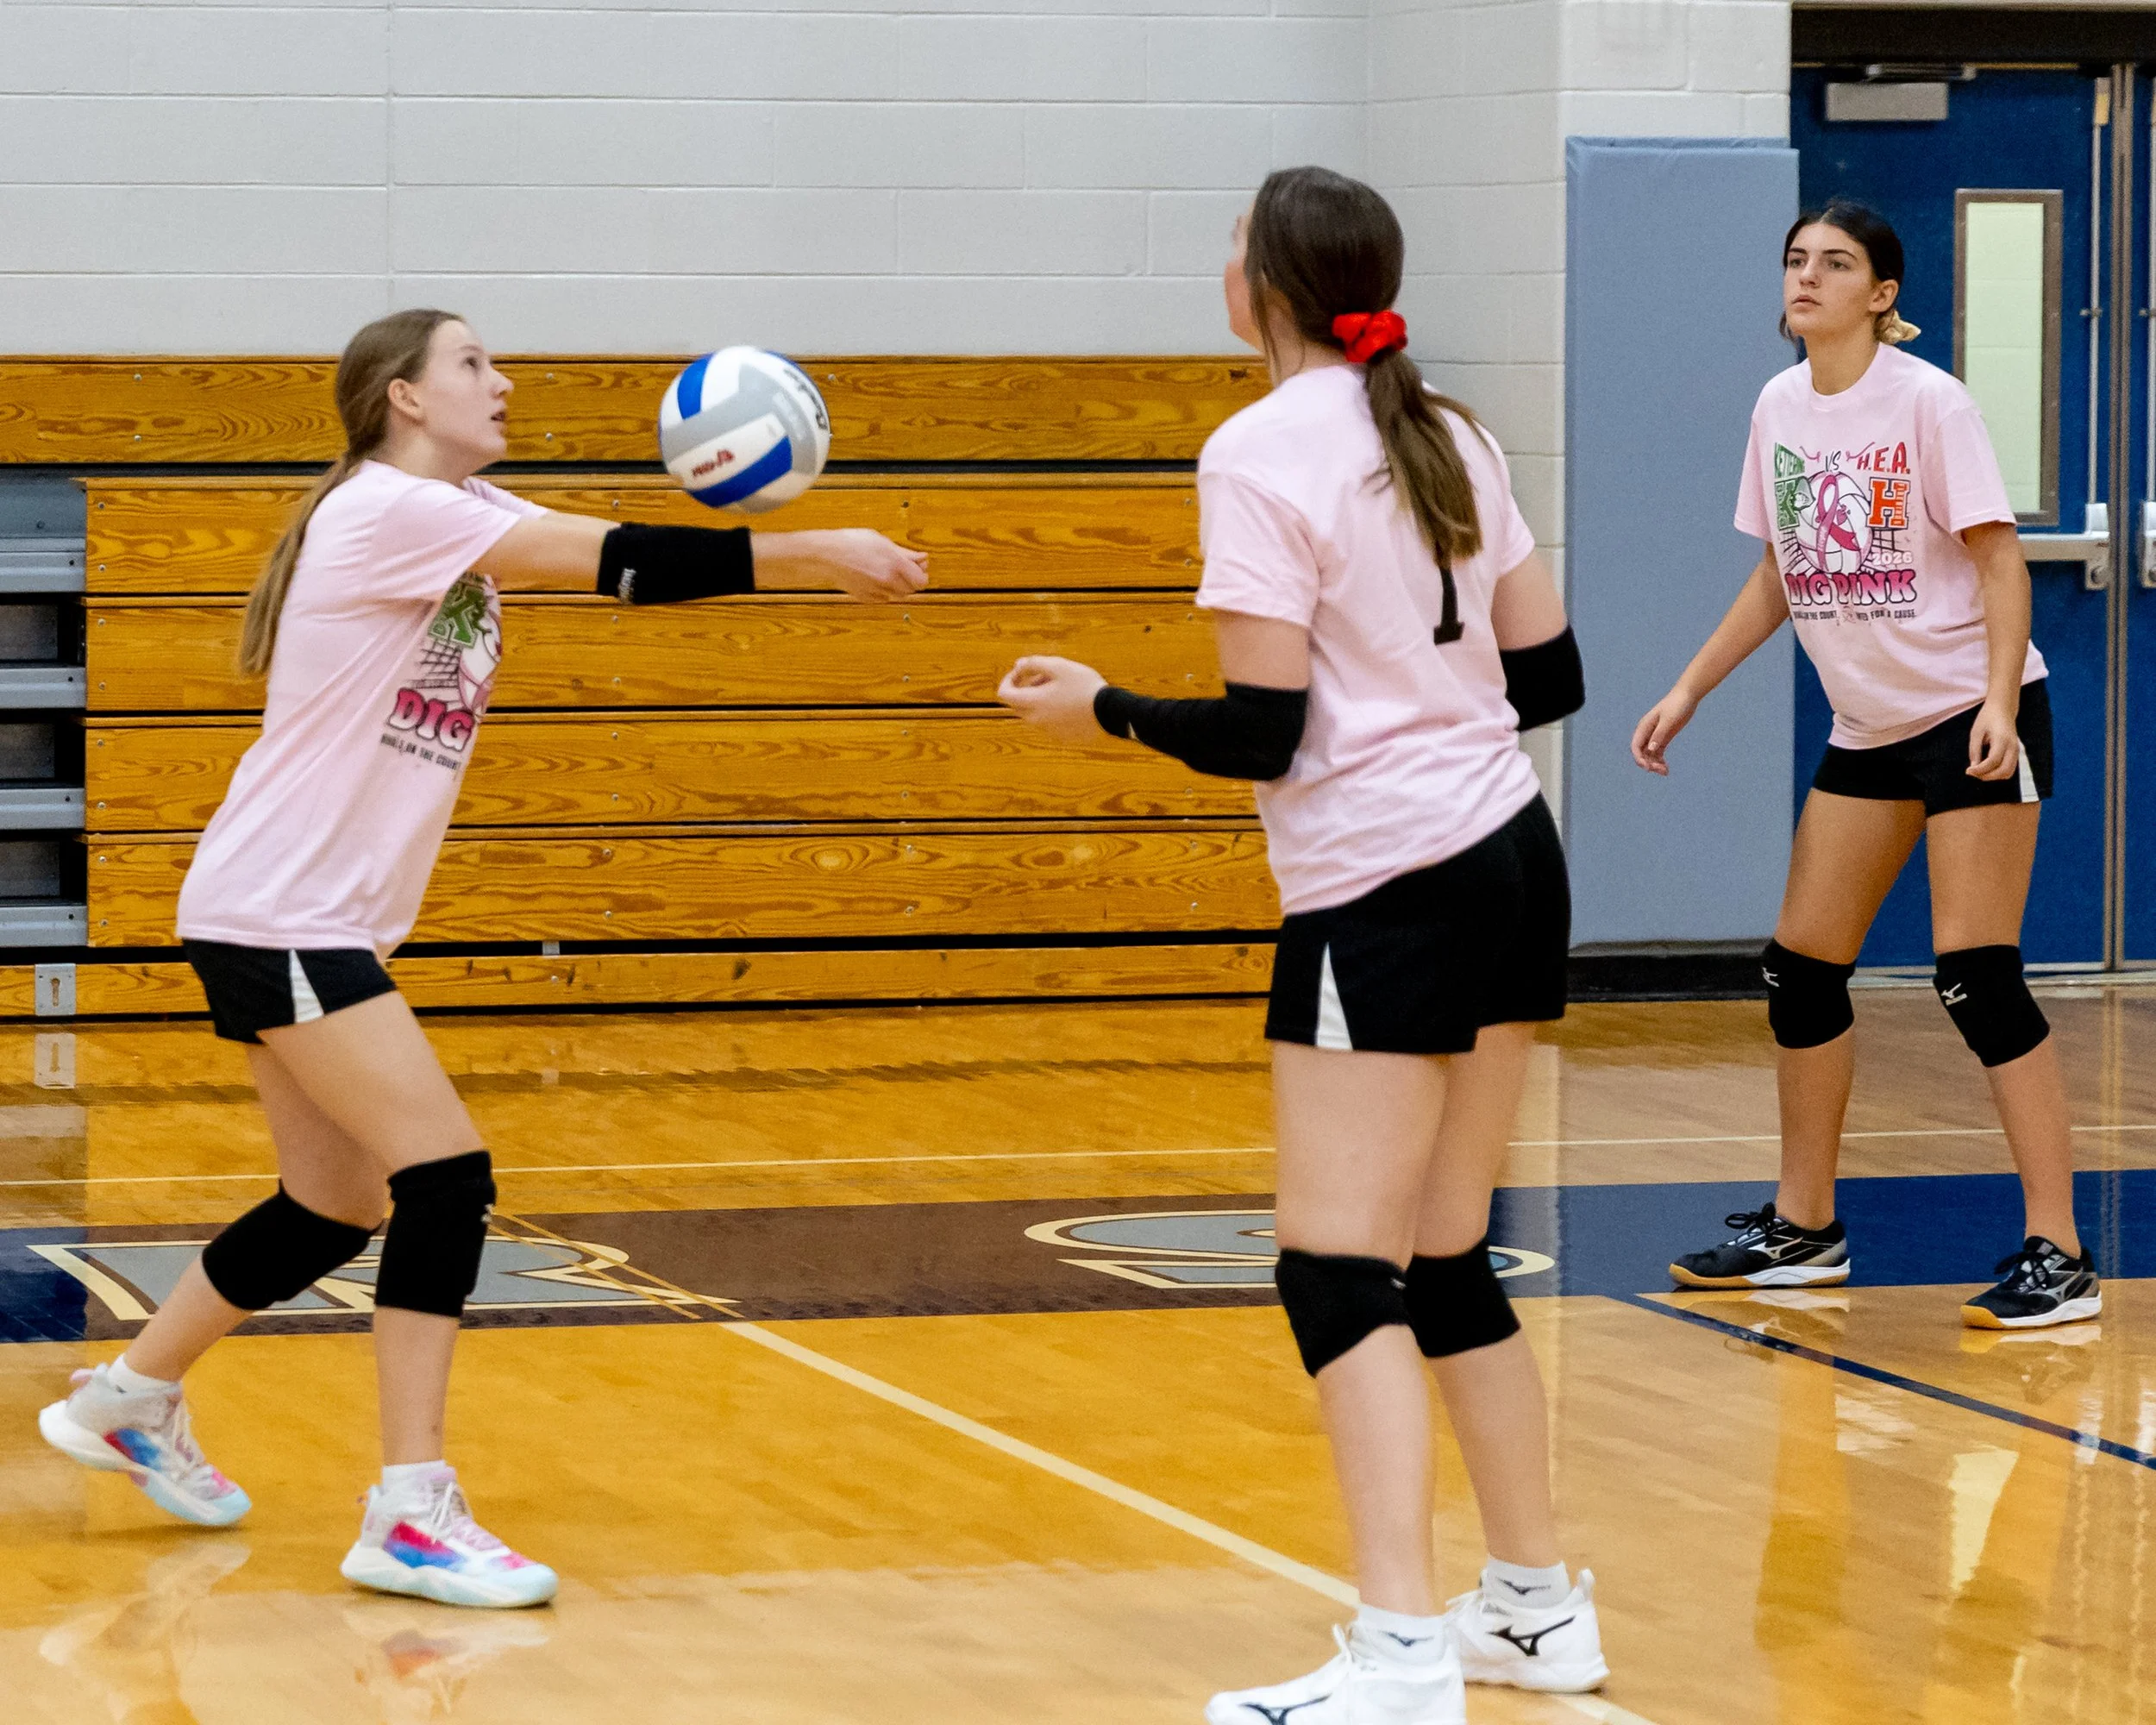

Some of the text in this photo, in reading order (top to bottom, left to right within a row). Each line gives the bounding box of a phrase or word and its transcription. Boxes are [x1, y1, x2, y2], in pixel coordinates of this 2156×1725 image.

[1856, 441, 1911, 474] H.E.A.
[1866, 476, 1911, 530] H
[1871, 551, 1914, 566] 2026
[1832, 568, 1918, 605] PINK
[387, 687, 475, 753] DIG
